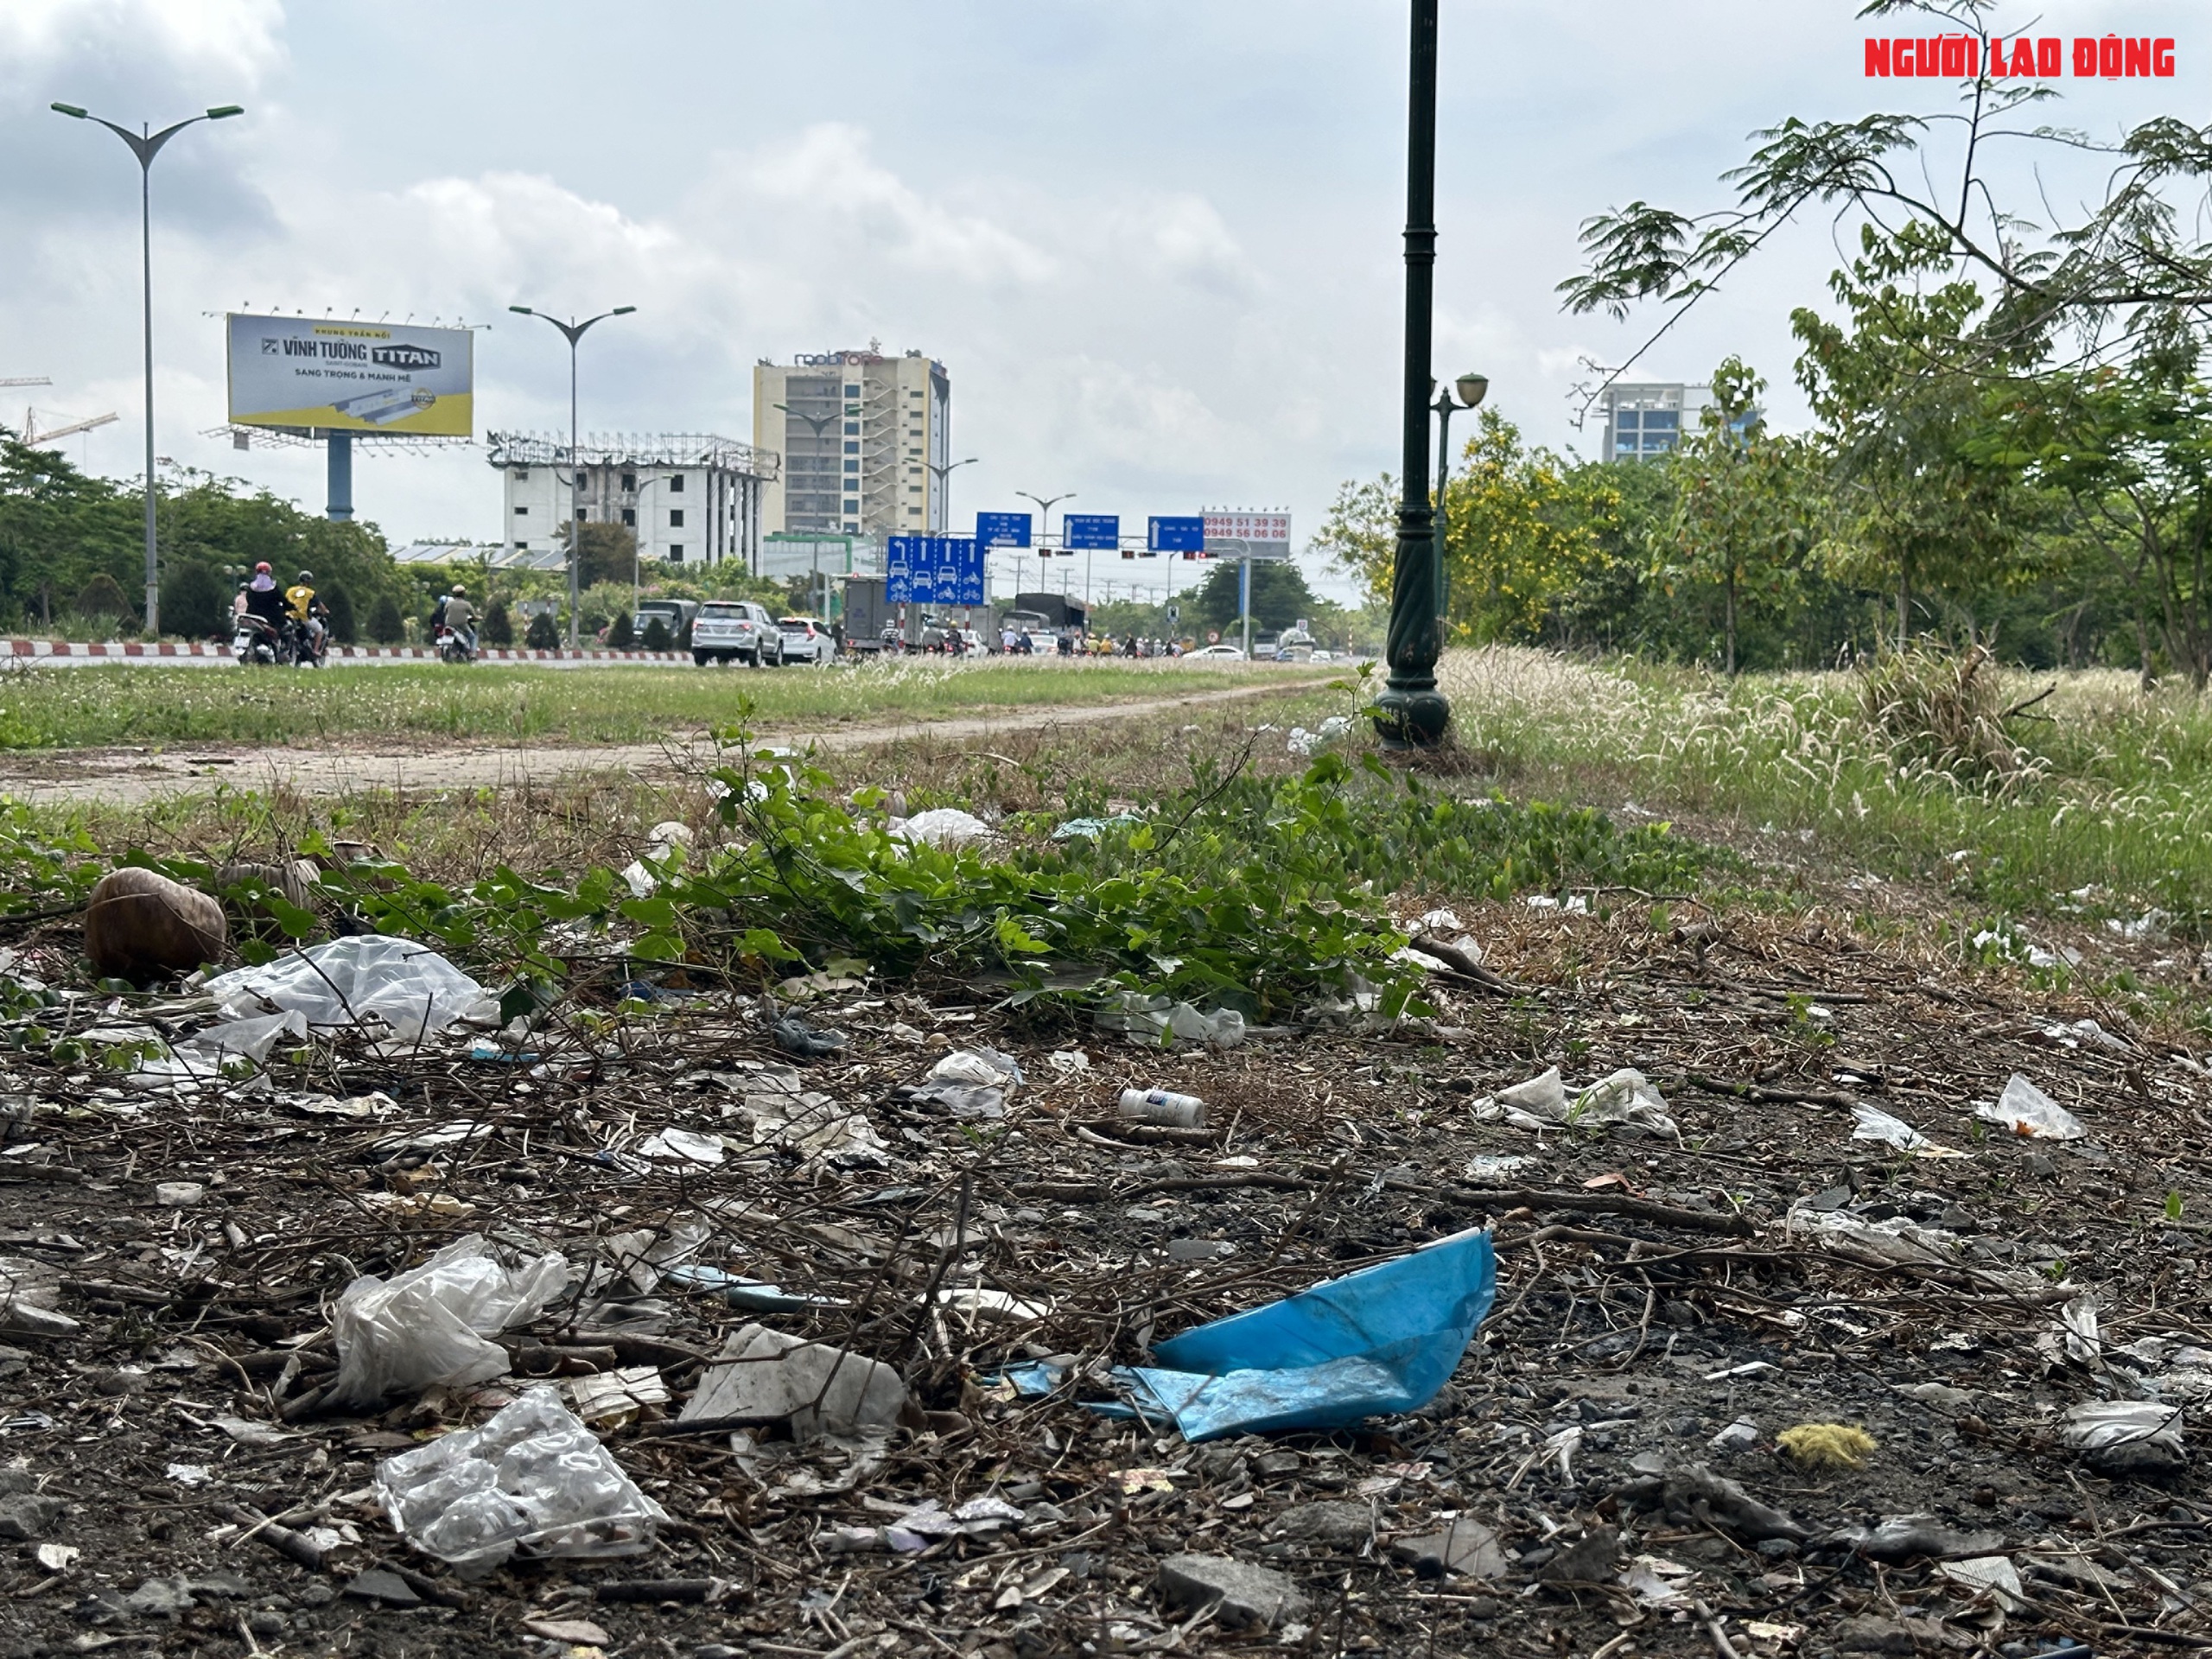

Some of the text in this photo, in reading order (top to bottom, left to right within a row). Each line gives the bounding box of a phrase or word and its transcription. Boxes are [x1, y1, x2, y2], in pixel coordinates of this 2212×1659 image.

[283, 336, 317, 358] VĨNH
[374, 349, 439, 365] TITAN
[295, 368, 322, 378] SANG
[1205, 518, 1287, 528] 0949 51 39 39
[1204, 528, 1233, 537] 0949
[1254, 529, 1268, 538] 06
[1272, 529, 1287, 539] 06
